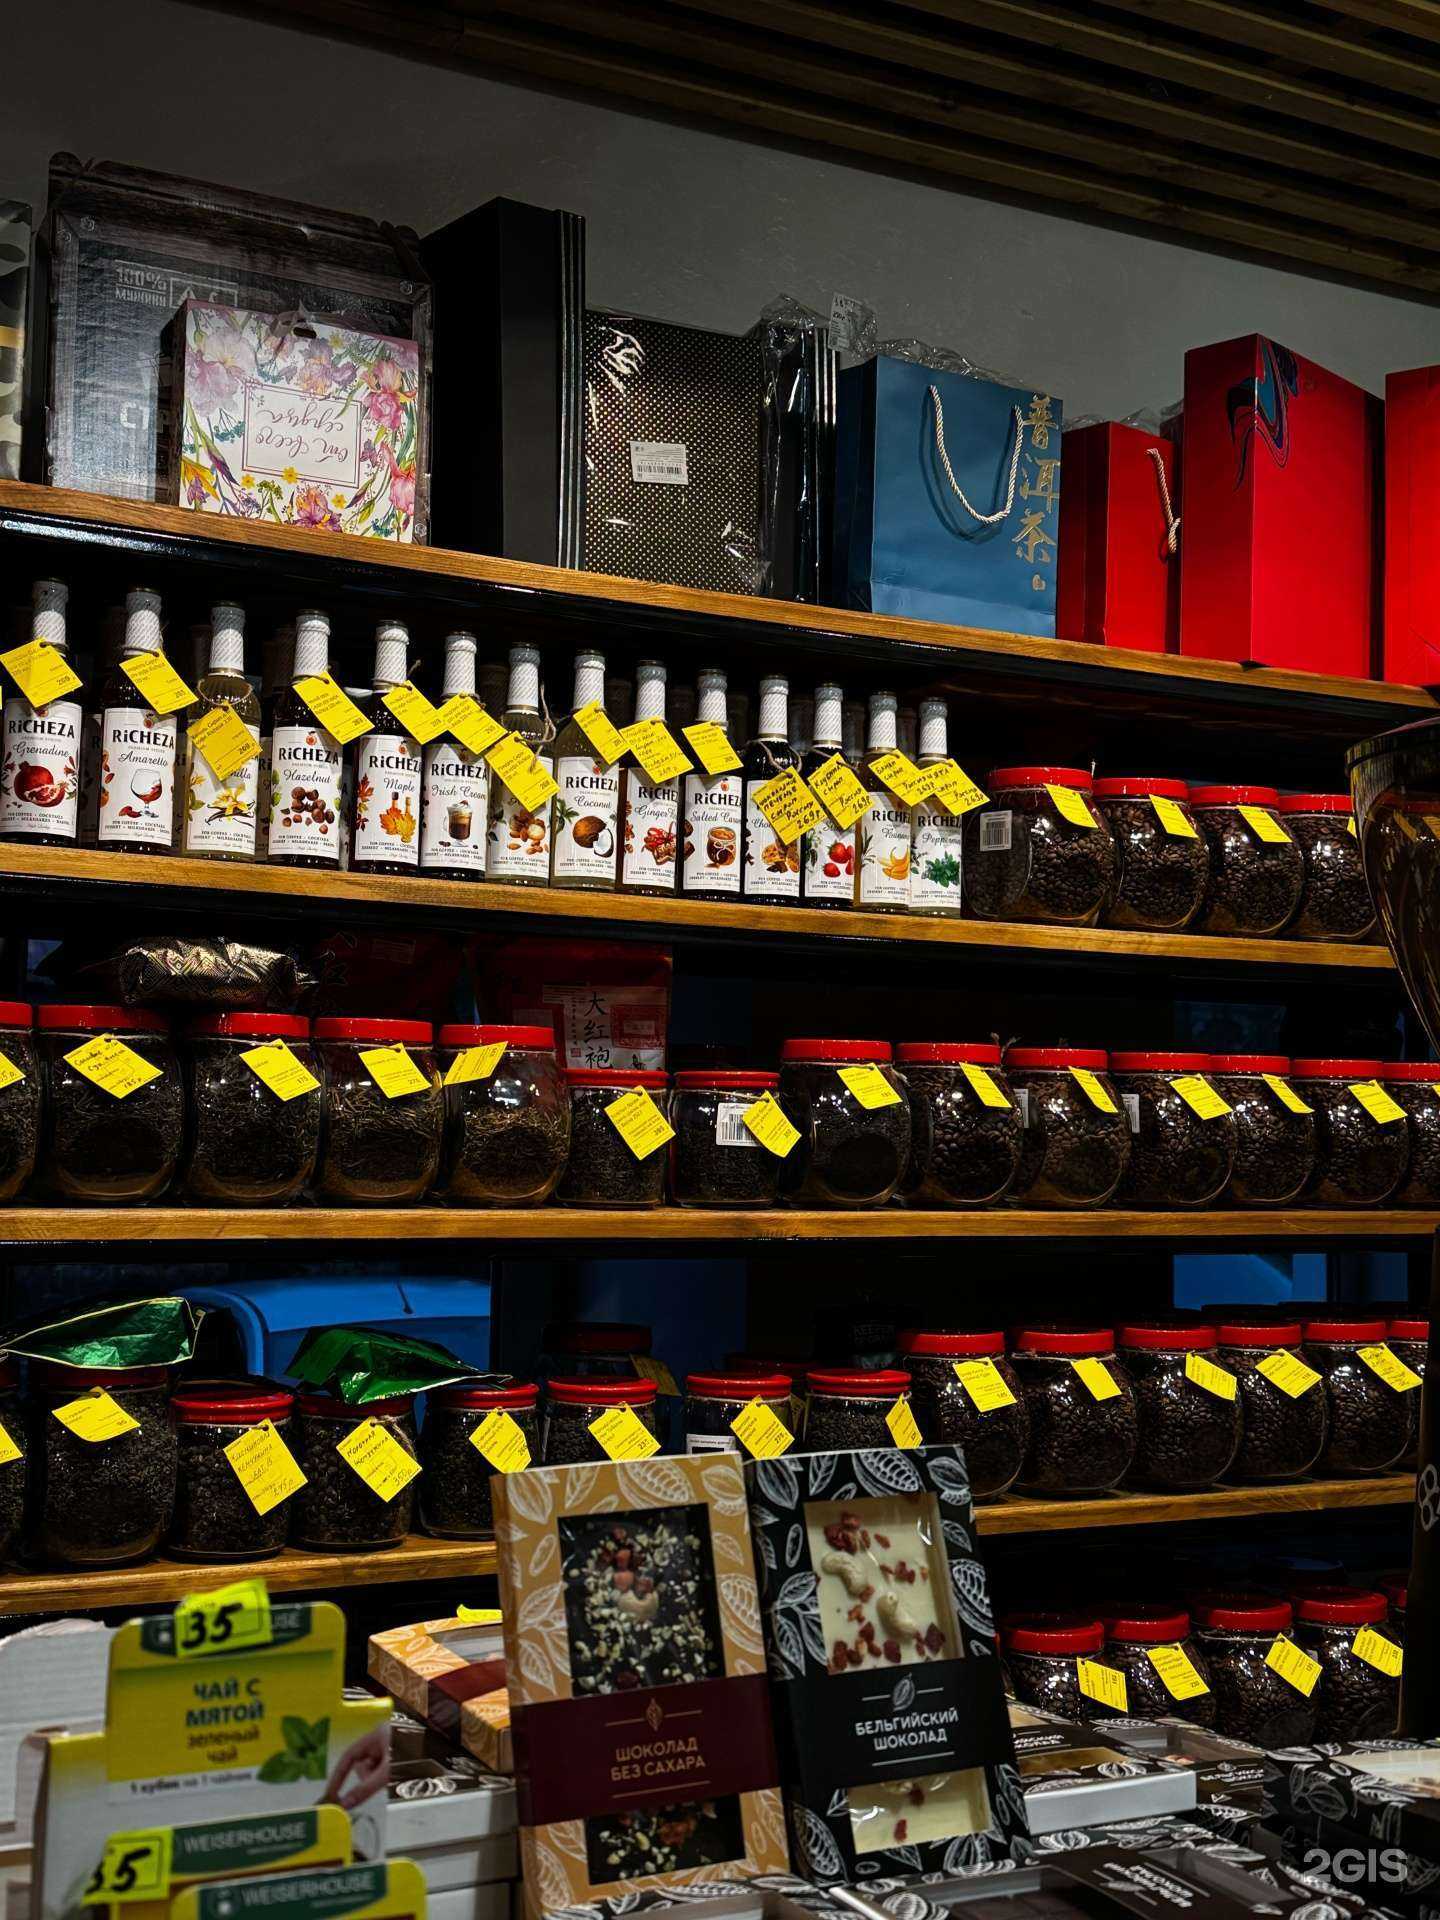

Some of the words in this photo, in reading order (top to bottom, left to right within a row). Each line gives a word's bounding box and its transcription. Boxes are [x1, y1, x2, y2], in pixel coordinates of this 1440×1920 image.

[256, 402, 343, 433] сердца
[13, 741, 74, 759] Grenadine
[118, 750, 169, 767] Amaretto
[283, 769, 332, 784] Hazelnut
[383, 777, 416, 793] Maple
[431, 784, 458, 797] Irish
[574, 796, 612, 809] Coconut
[634, 805, 668, 820] Ginger
[690, 810, 718, 822] Salted
[181, 1603, 244, 1649] 35
[193, 1676, 239, 1700] ЧАЙ
[245, 1677, 262, 1697] С
[186, 1699, 263, 1728] МЯТОЙ
[855, 1707, 959, 1737] БЕЛЬГИЙСКИЙ
[615, 1737, 699, 1762] ШОКОЛАД
[873, 1729, 948, 1753] ШОКОЛАД
[610, 1759, 642, 1782] БЕЗ
[643, 1754, 707, 1777] САХАРА
[184, 1822, 306, 1852] WEISERHOUSE
[240, 1872, 375, 1906] WEISERHOUSE
